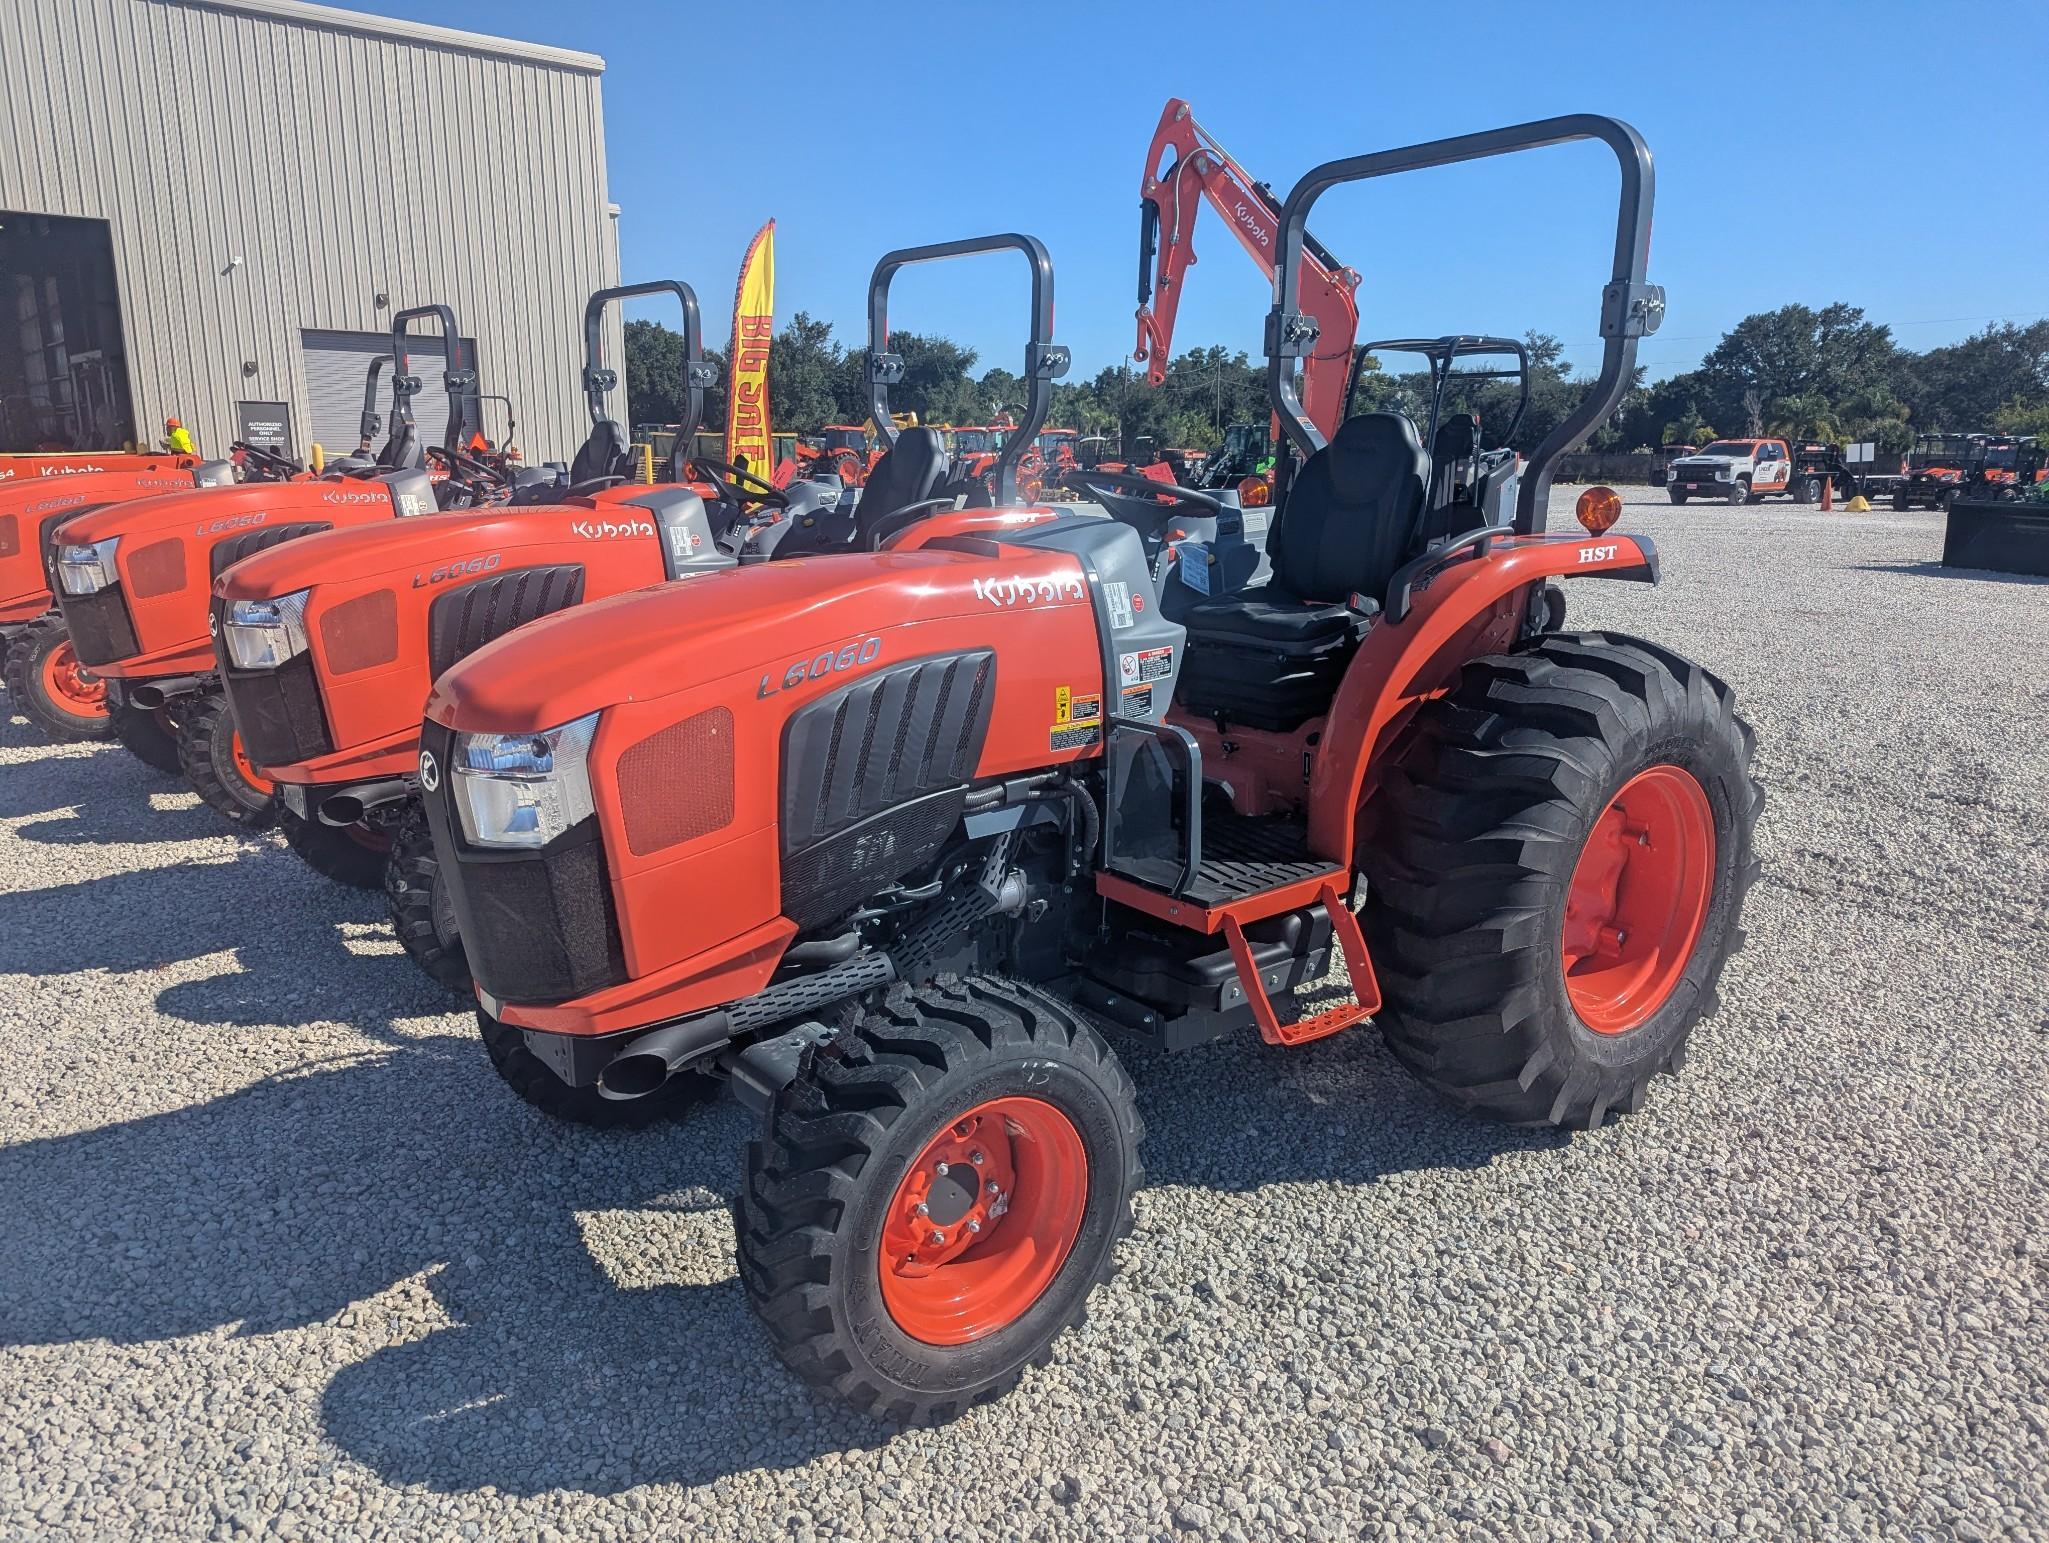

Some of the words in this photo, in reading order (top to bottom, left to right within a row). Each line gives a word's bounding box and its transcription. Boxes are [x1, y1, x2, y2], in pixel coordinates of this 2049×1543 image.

[1234, 201, 1270, 247] Kubota
[739, 315, 772, 373] BIG
[735, 382, 766, 461] SALE
[322, 490, 389, 504] Kubota
[196, 512, 267, 536] L6060
[571, 519, 654, 538] Kubota
[412, 553, 501, 589] L6060
[1577, 545, 1618, 564] HST
[973, 574, 1084, 606] Kubota
[757, 637, 881, 700] L6060
